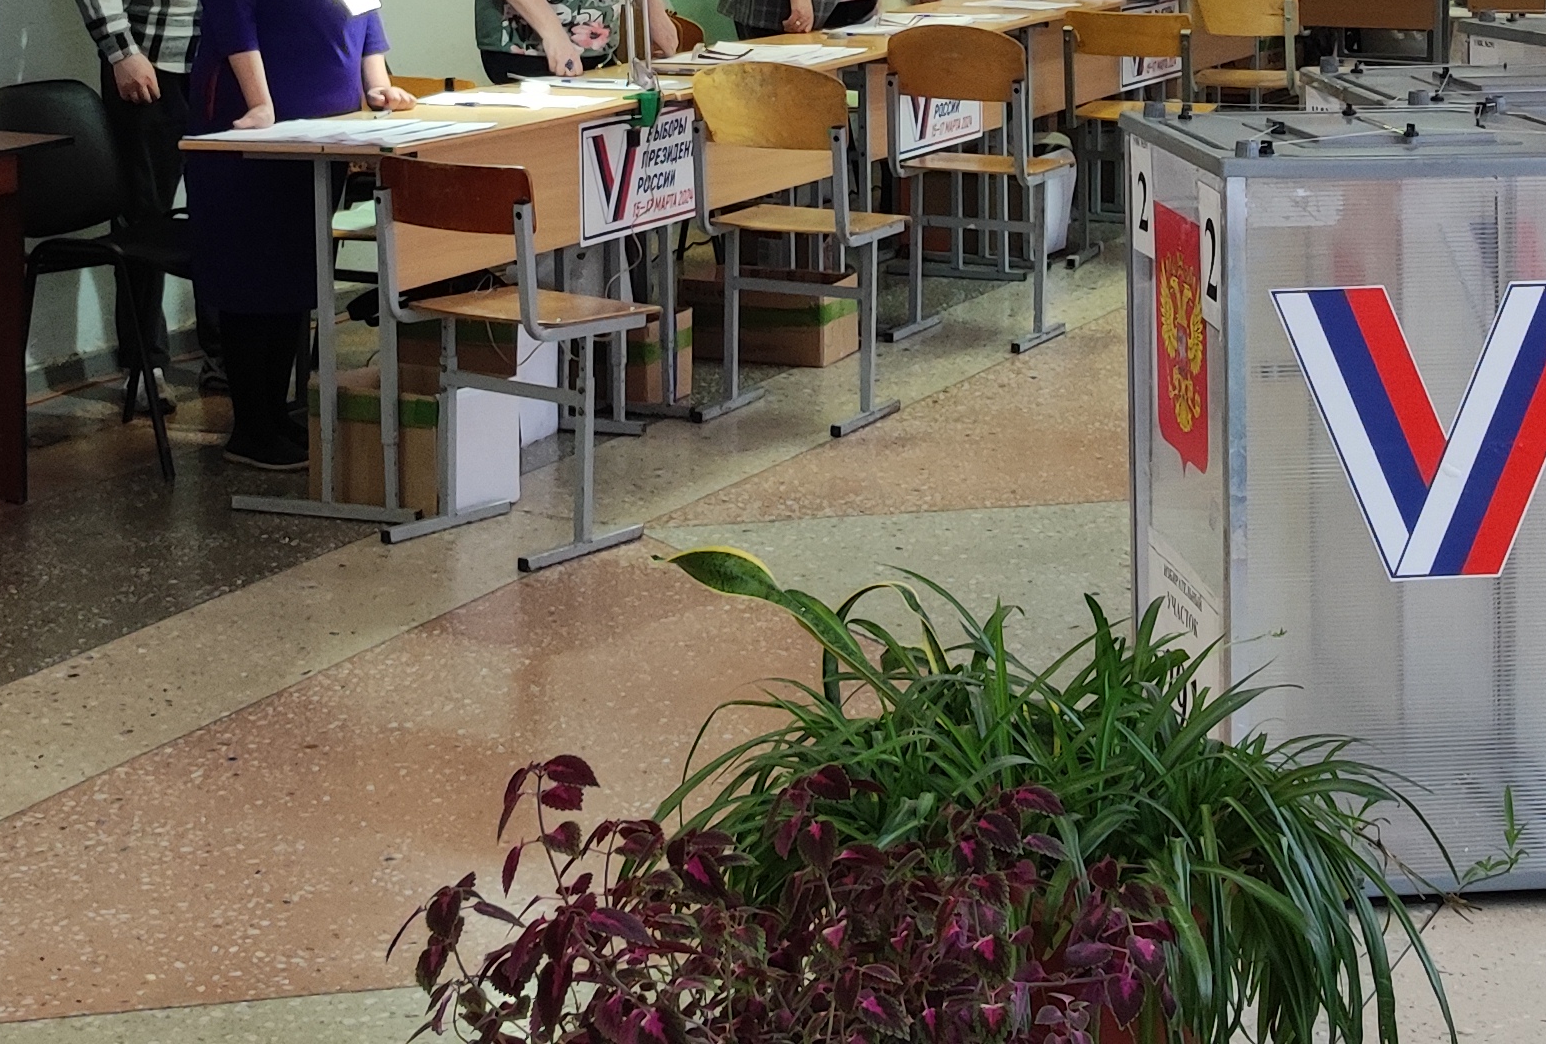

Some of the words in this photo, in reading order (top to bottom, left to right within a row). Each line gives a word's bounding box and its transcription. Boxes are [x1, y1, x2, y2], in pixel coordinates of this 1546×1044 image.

[636, 169, 676, 195] РОССИИ
[1137, 171, 1149, 232] 2
[1204, 217, 1218, 303] 2
